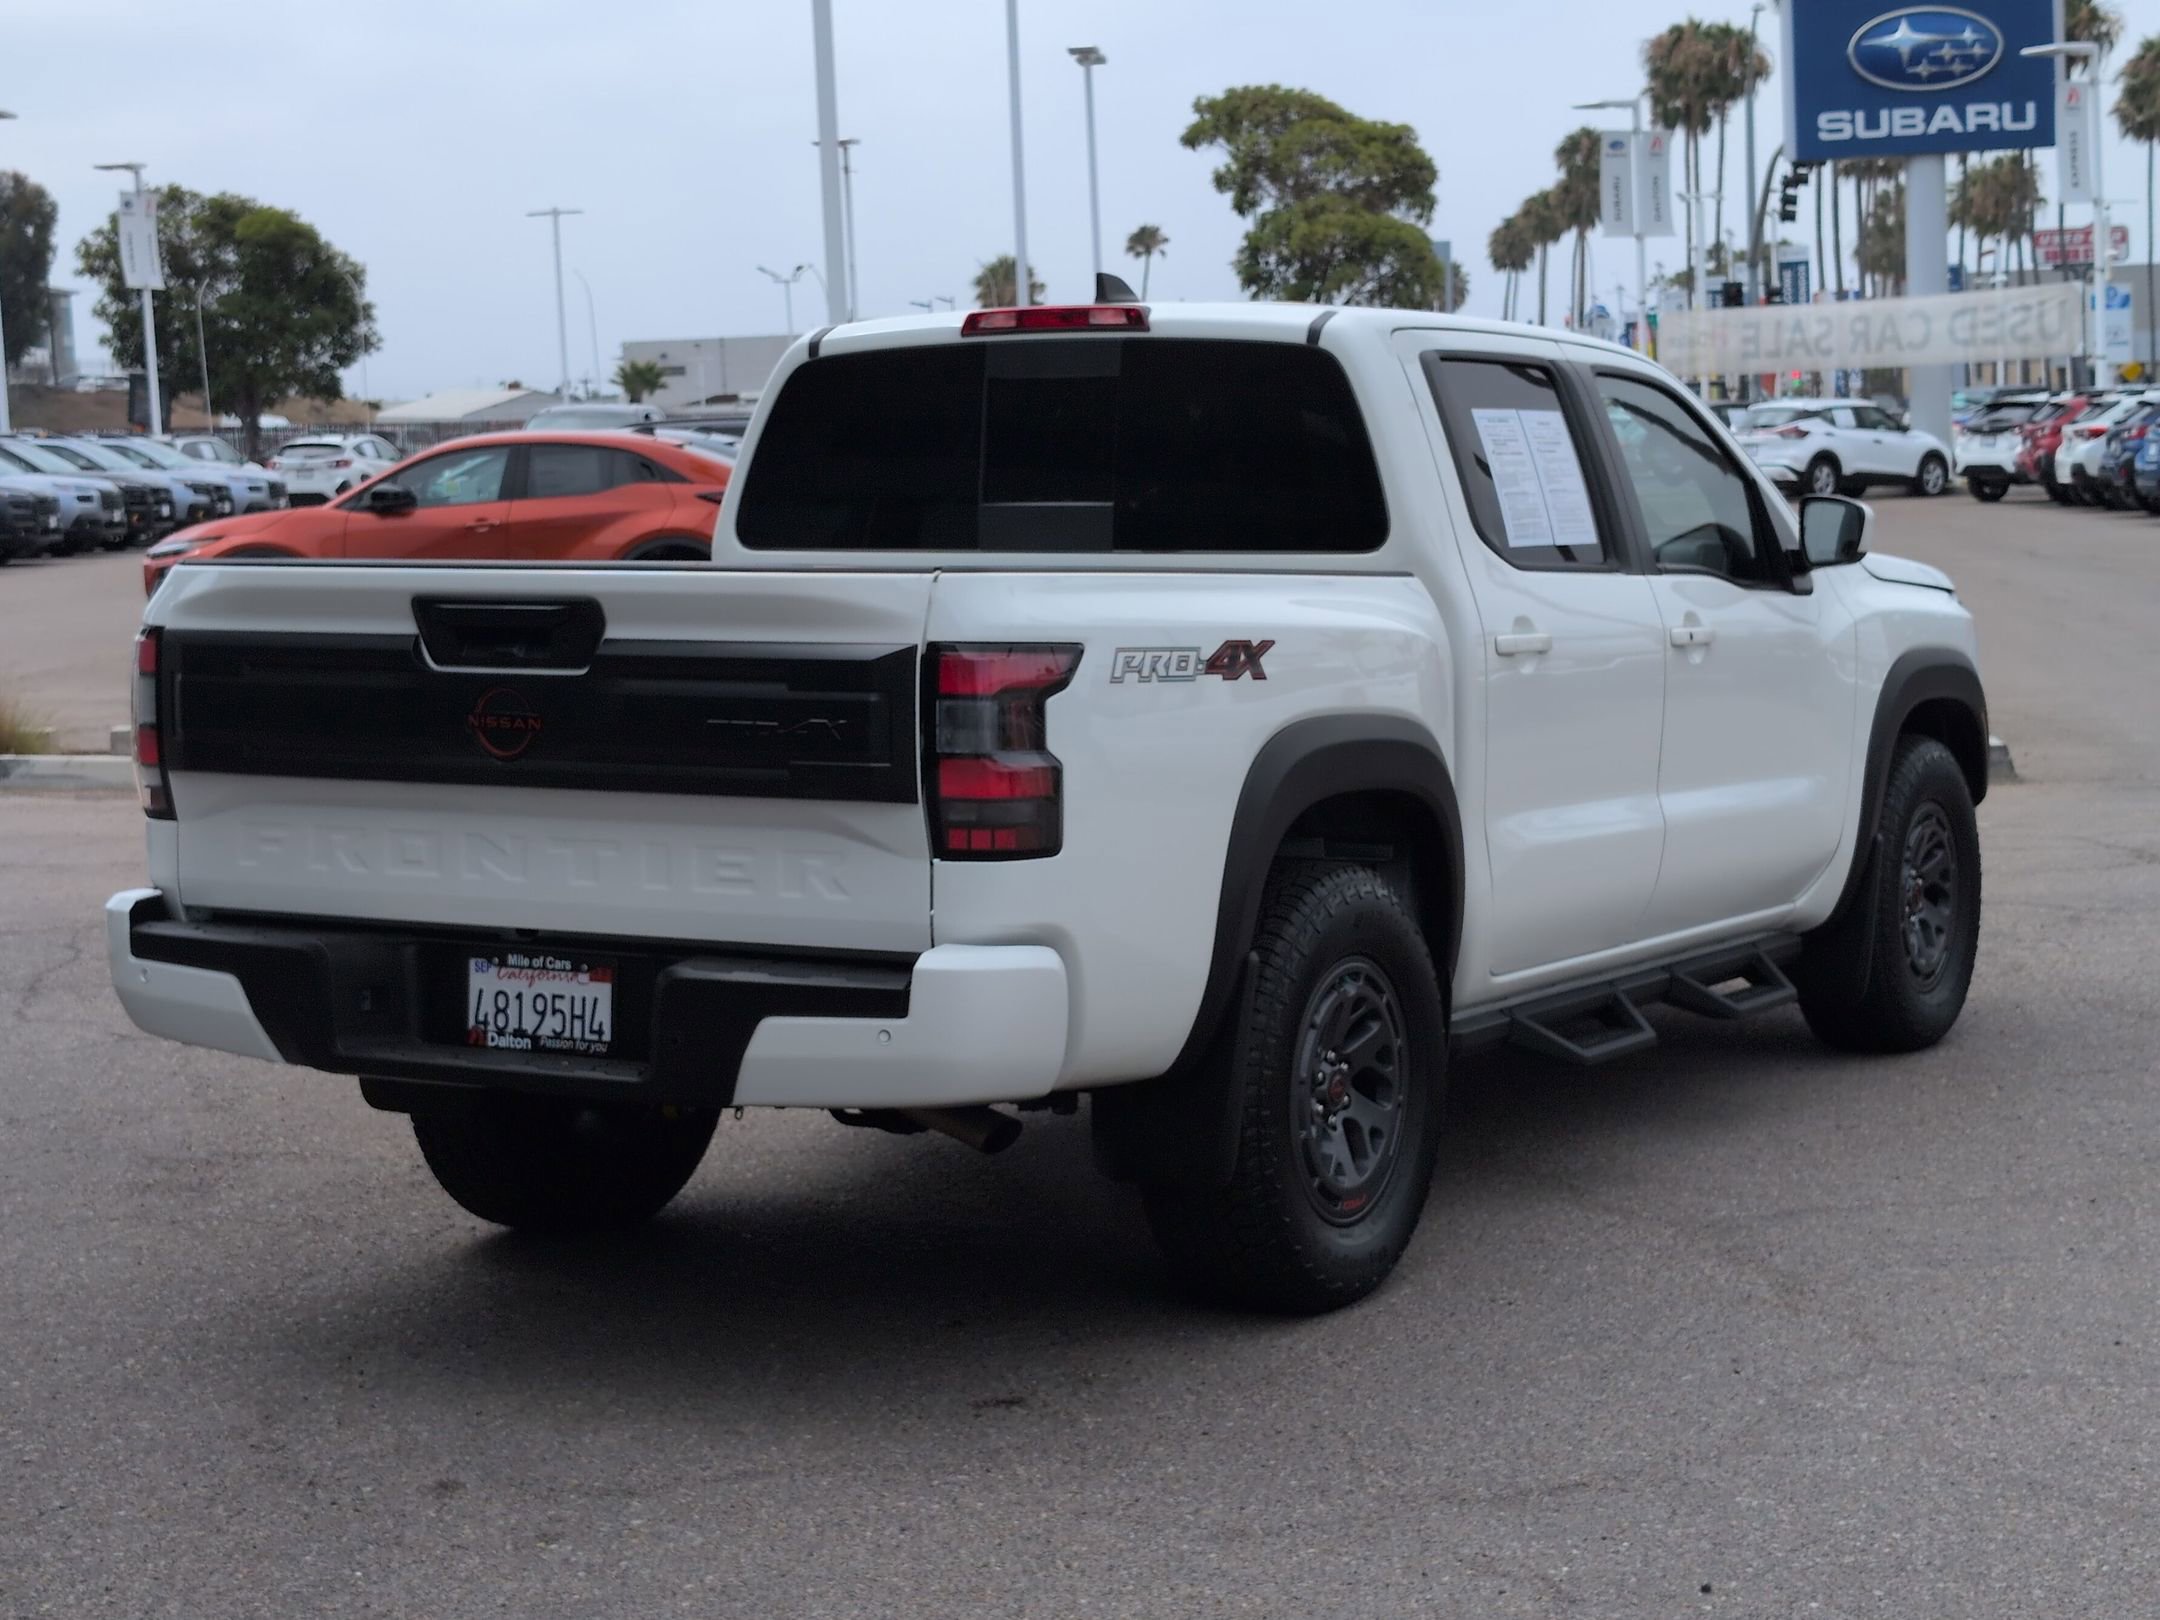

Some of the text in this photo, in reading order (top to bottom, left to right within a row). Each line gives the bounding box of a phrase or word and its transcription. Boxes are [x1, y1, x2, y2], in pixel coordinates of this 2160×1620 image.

[1816, 101, 2037, 142] SUBARU
[1110, 639, 1276, 684] PRO-4X
[467, 714, 543, 730] NISSAN
[237, 821, 851, 900] FRONTIER
[507, 952, 572, 970] Mile of Cars
[474, 988, 606, 1041] 48195H4
[487, 1031, 608, 1055] Dalton Passion for you
